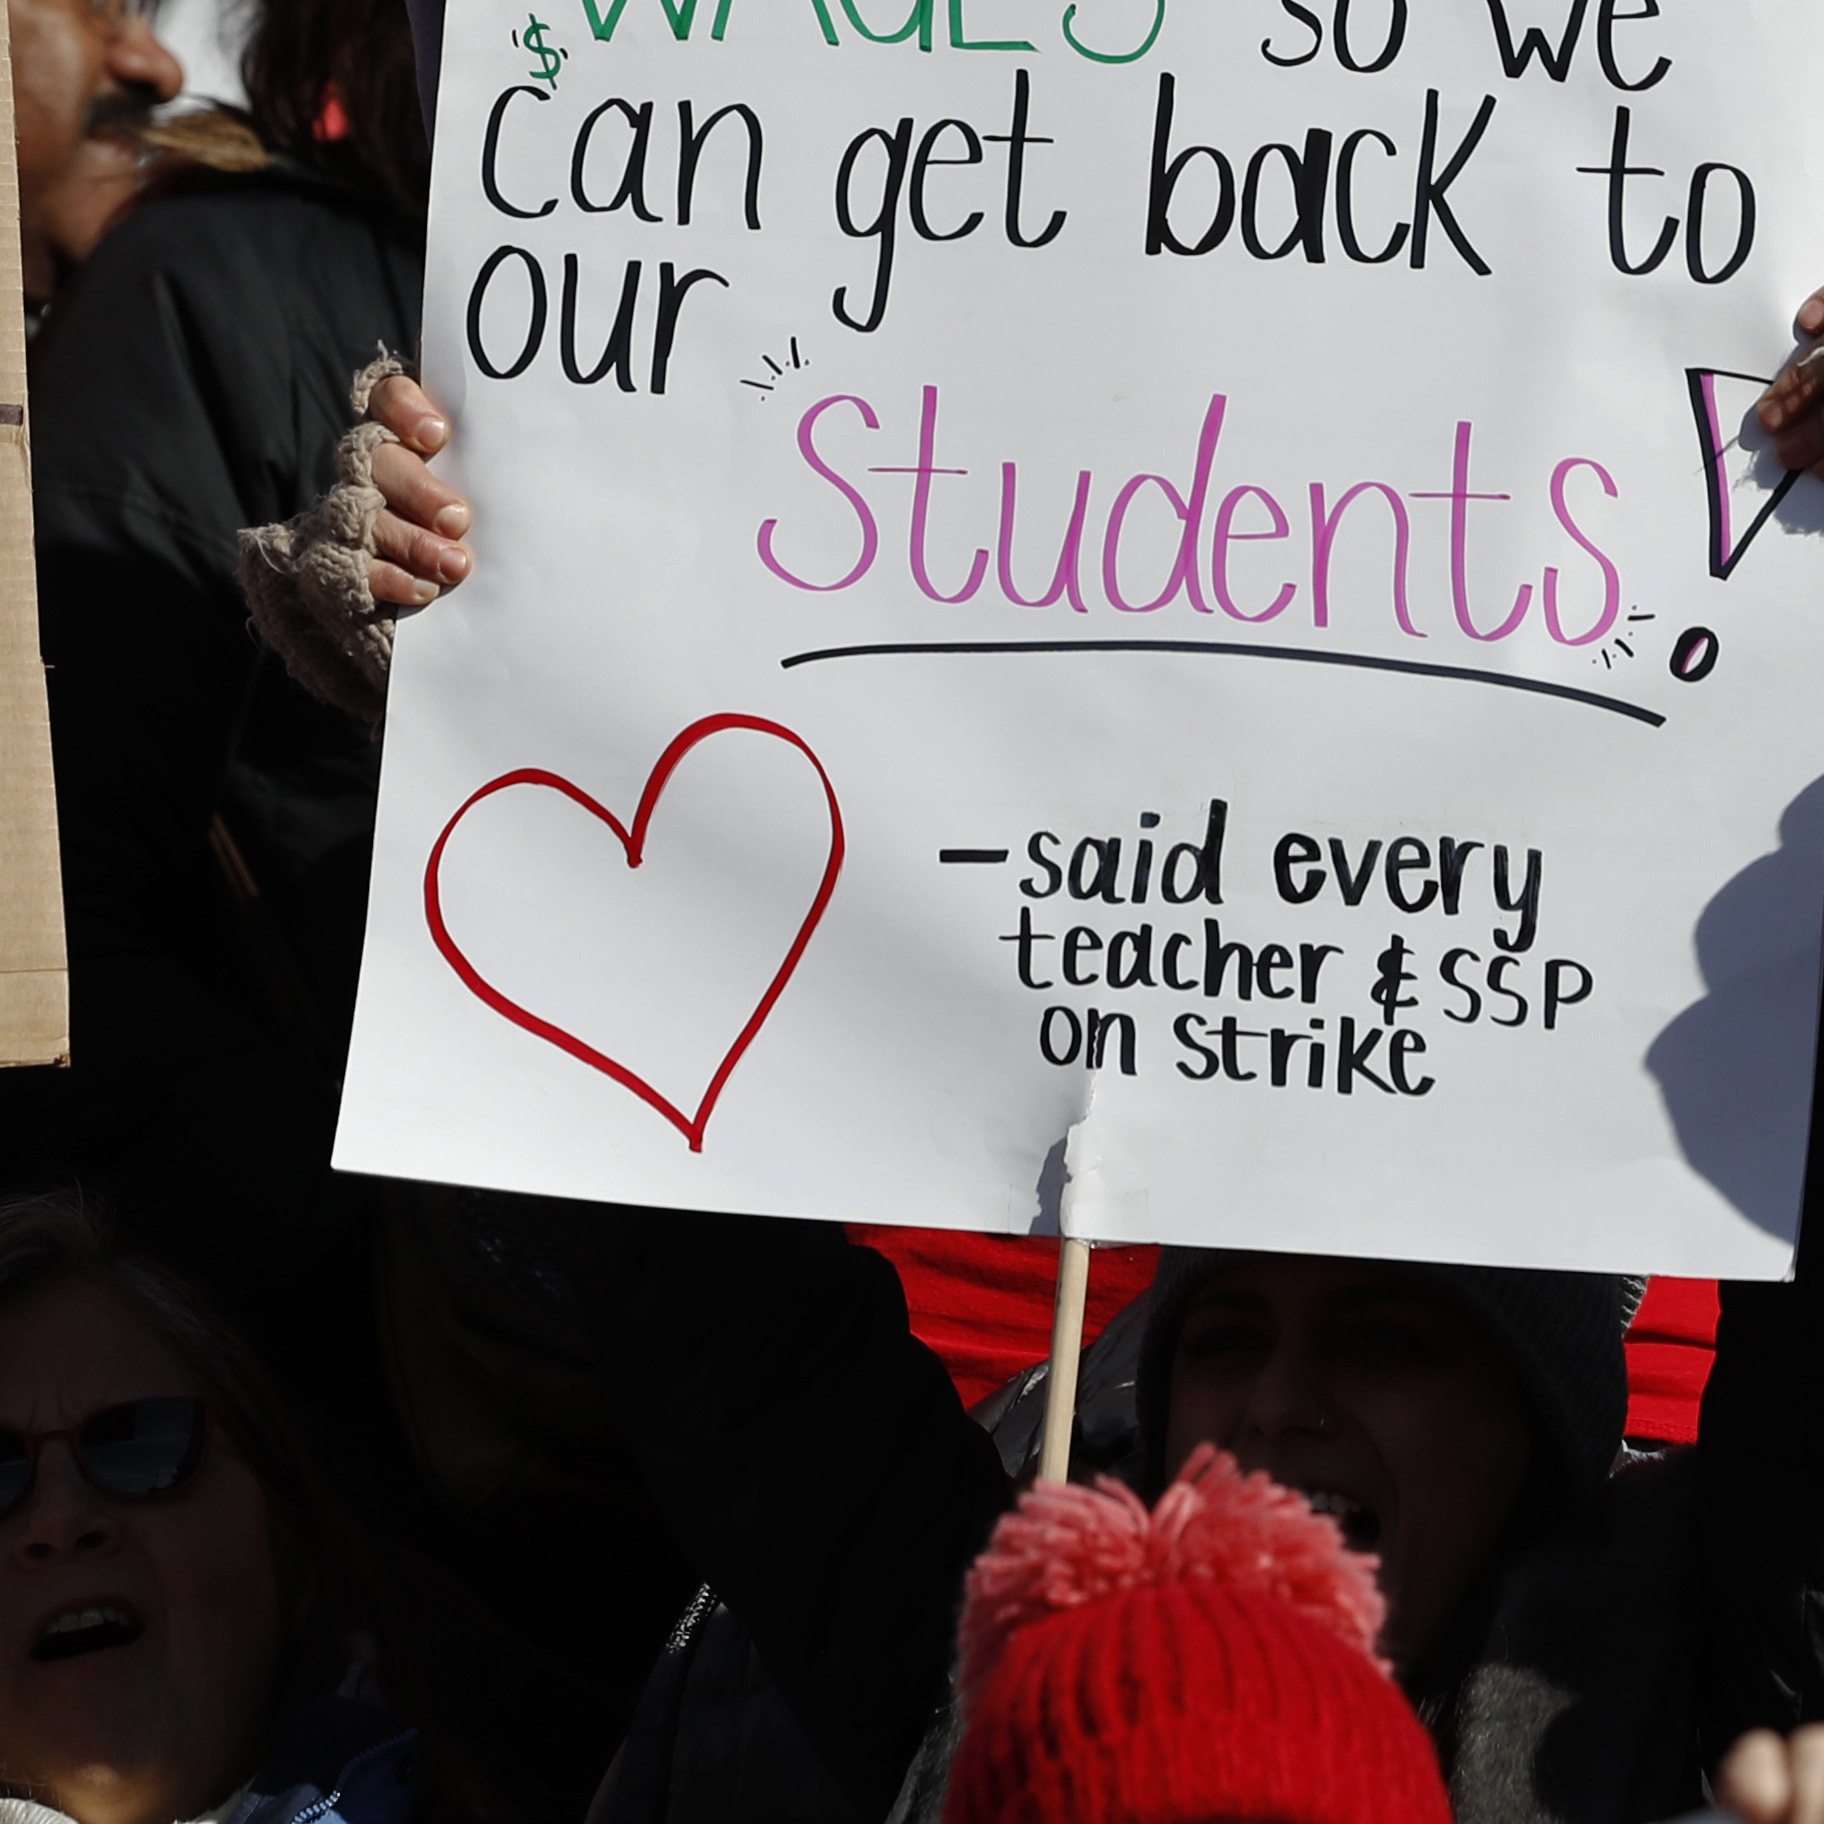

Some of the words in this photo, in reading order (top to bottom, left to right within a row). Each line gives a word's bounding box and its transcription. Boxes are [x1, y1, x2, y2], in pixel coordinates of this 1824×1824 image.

[480, 84, 765, 231] can
[831, 67, 1068, 333] get
[1143, 71, 1497, 277] back
[1575, 105, 1757, 286] to
[466, 244, 730, 395] our
[1273, 830, 1544, 955] every
[997, 905, 1345, 1004] teacher
[1369, 933, 1421, 1026] &
[1437, 945, 1594, 1031] SSP
[1039, 1004, 1138, 1076] on
[1171, 1010, 1435, 1097] strike
